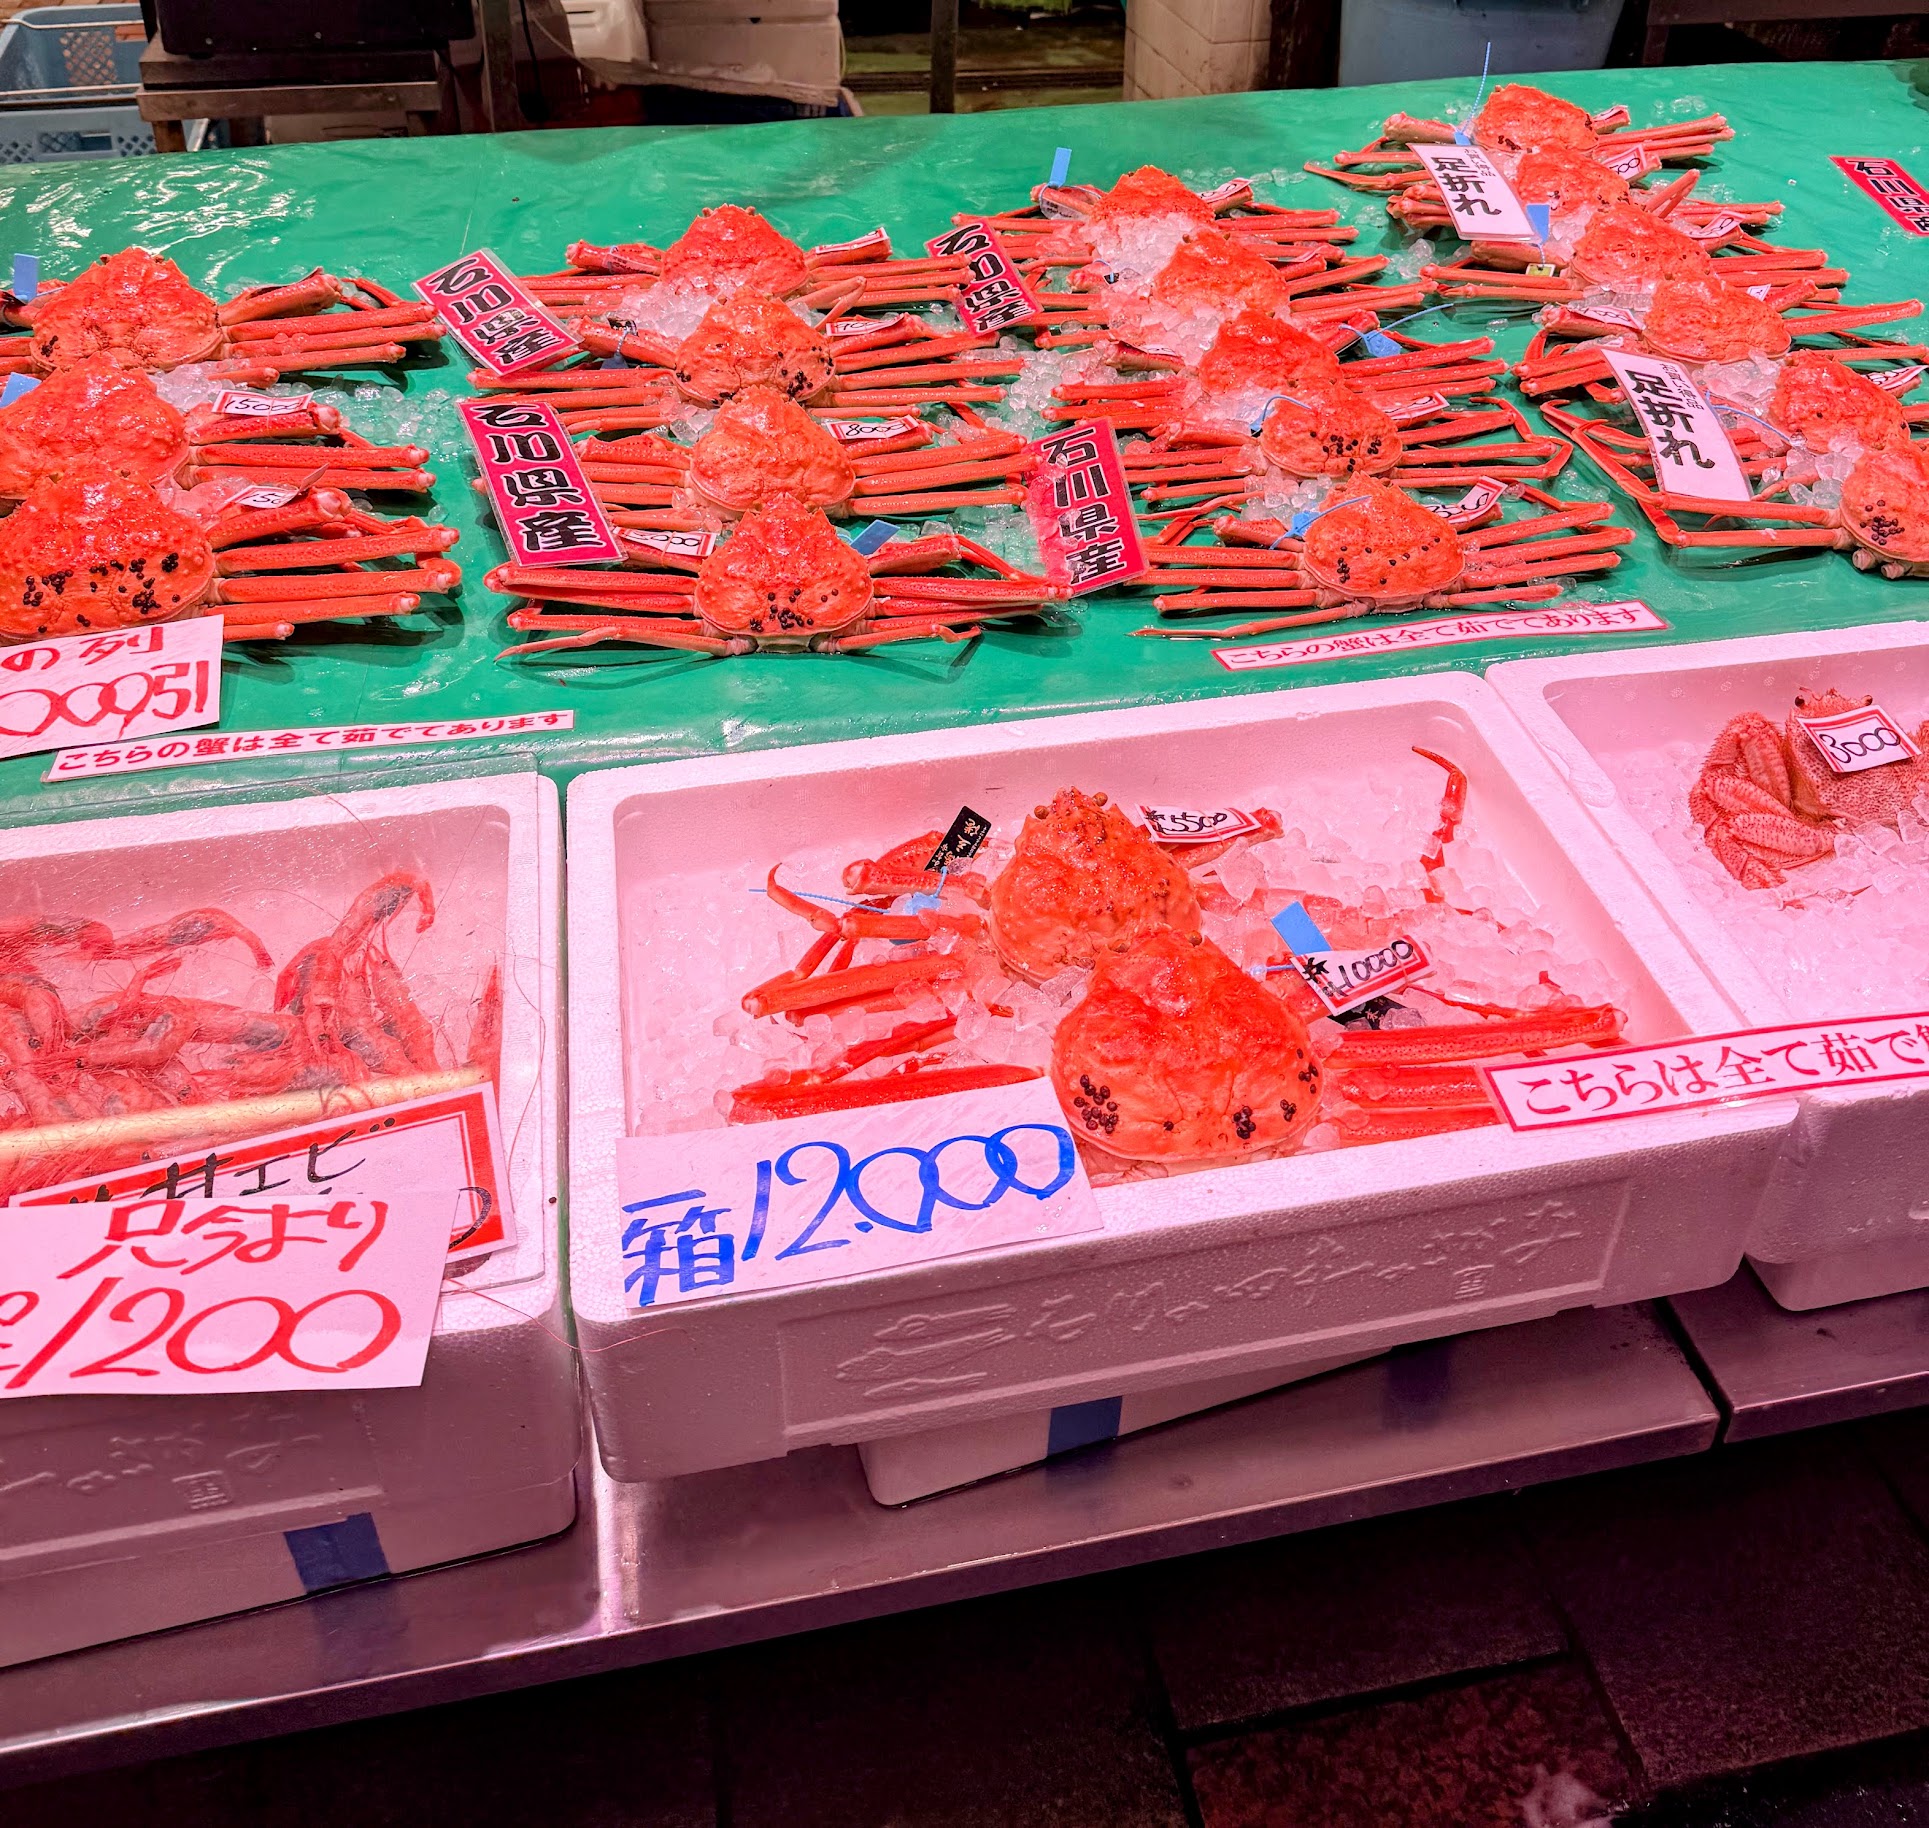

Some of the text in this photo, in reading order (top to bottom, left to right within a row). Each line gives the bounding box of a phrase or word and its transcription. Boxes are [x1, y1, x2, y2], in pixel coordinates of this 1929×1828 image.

[1430, 156, 1503, 216] 足折れ
[427, 257, 564, 366] 石川県産
[935, 222, 1035, 333] 石川県産
[845, 423, 906, 437] 8000
[1624, 369, 1716, 469] 足折れ
[472, 404, 608, 552] 石川県産
[1042, 428, 1128, 587] 石川県産
[1229, 606, 1641, 665] こちらの蟹は全て茹でてあります
[58, 711, 567, 771] こちらの蟹は全て茹でてあります
[1818, 727, 1902, 764] 3000
[57, 1200, 389, 1275] 只今より
[622, 1189, 735, 1307] 一箱
